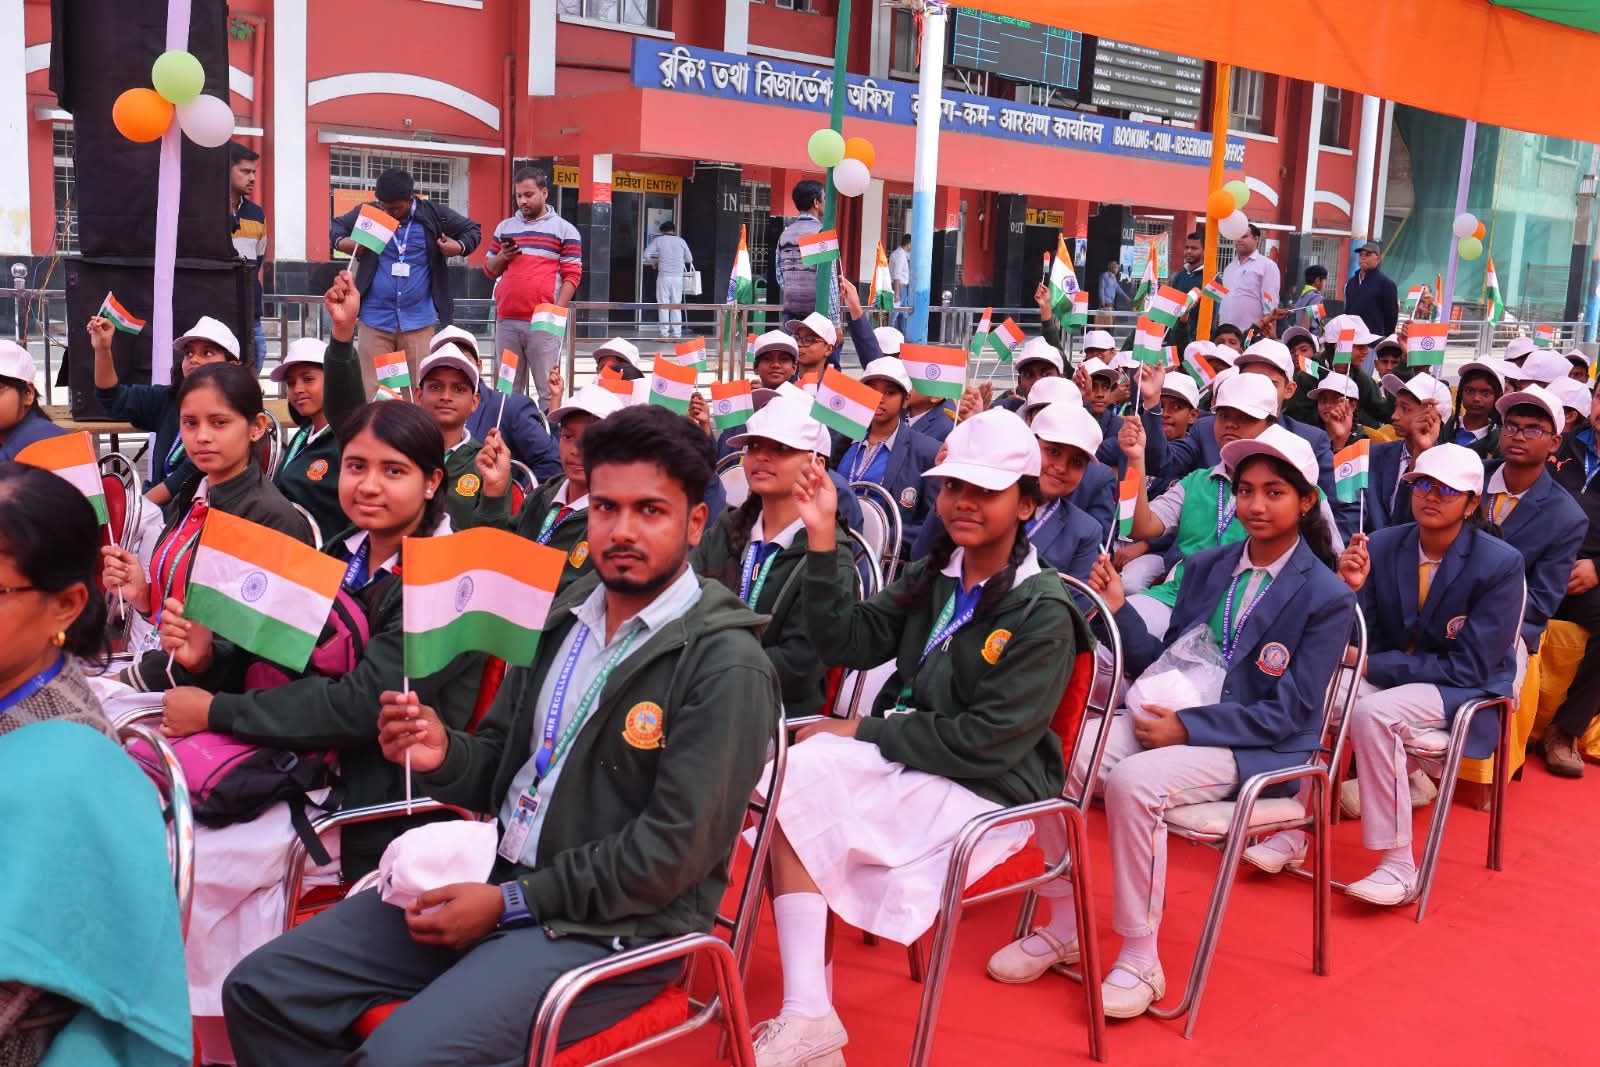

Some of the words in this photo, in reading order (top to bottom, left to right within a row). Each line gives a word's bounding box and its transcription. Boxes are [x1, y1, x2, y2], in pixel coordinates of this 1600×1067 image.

[658, 46, 706, 89] বুকিং
[709, 61, 751, 95] তথা
[754, 60, 834, 107] রিজার্ভেশ
[846, 78, 896, 116] অফিস
[1000, 108, 1051, 137] आरक्षण
[1053, 113, 1104, 144] कार्यालय
[646, 179, 679, 192] ENTRY
[723, 193, 738, 212] IN
[1010, 221, 1024, 234] OUT
[1122, 228, 1134, 240] OUT
[551, 655, 576, 716] EXCELLENCE
